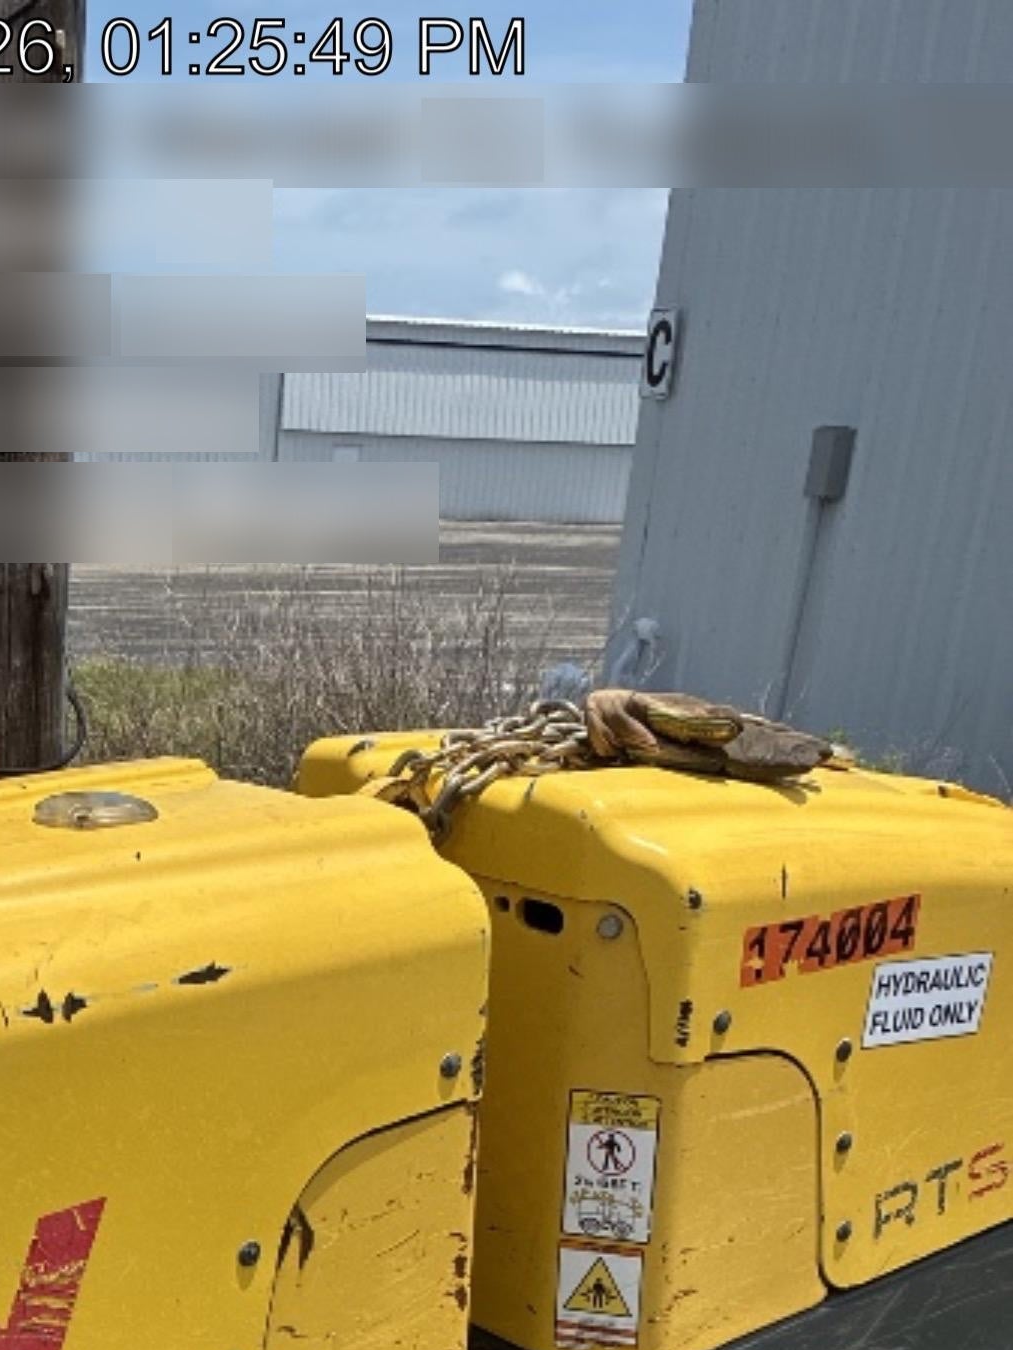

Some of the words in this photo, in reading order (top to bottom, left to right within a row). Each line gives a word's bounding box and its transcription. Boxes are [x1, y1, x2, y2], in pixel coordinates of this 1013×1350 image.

[646, 319, 673, 388] C
[747, 894, 917, 982] 174004
[875, 961, 987, 999] HYDRAULIC
[868, 1006, 925, 1036] FLUID
[928, 998, 979, 1029] ONLY
